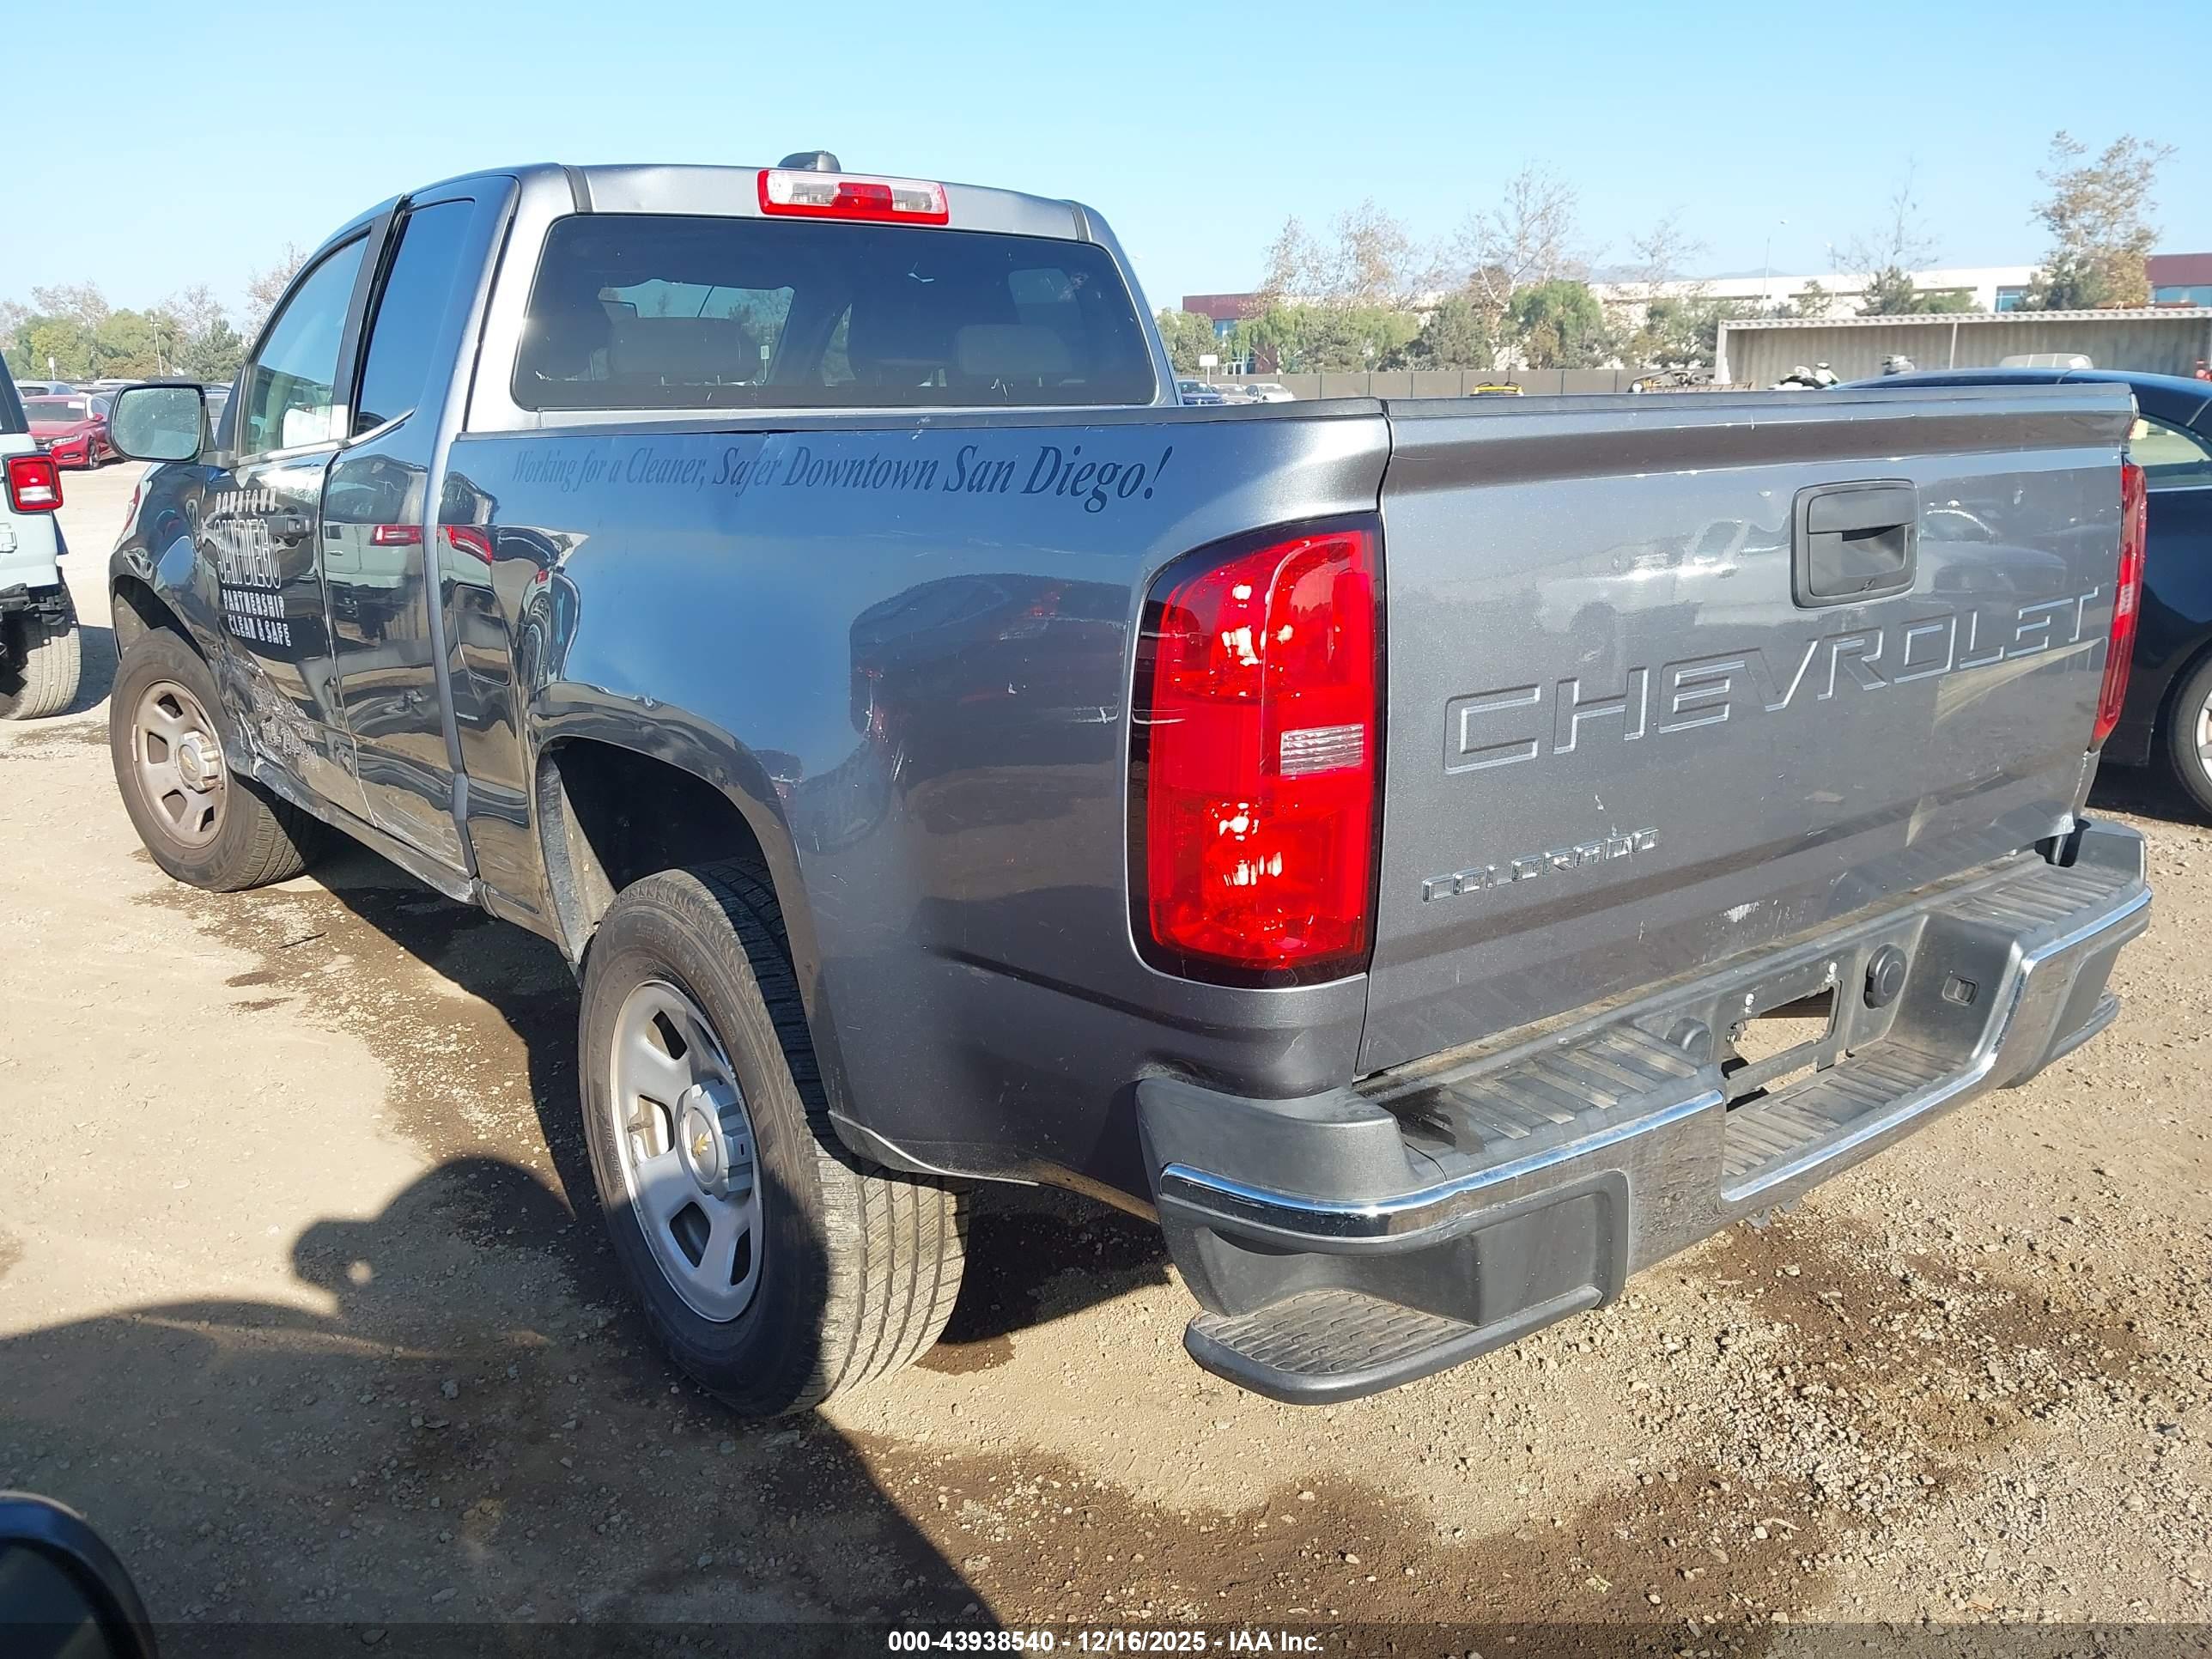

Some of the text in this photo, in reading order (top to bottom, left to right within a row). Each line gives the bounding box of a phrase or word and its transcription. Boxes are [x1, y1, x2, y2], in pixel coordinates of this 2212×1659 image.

[215, 487, 276, 514] DOWNTOWN
[512, 444, 1174, 514] Working for a Cleaner, Safer Downtown San Diego!
[222, 589, 285, 619] PARTNERSHIP
[228, 614, 257, 640] CLEAN
[264, 620, 292, 647] SAFE
[1443, 584, 2108, 775] CHEVROLET
[1422, 827, 1659, 903] COLORADO
